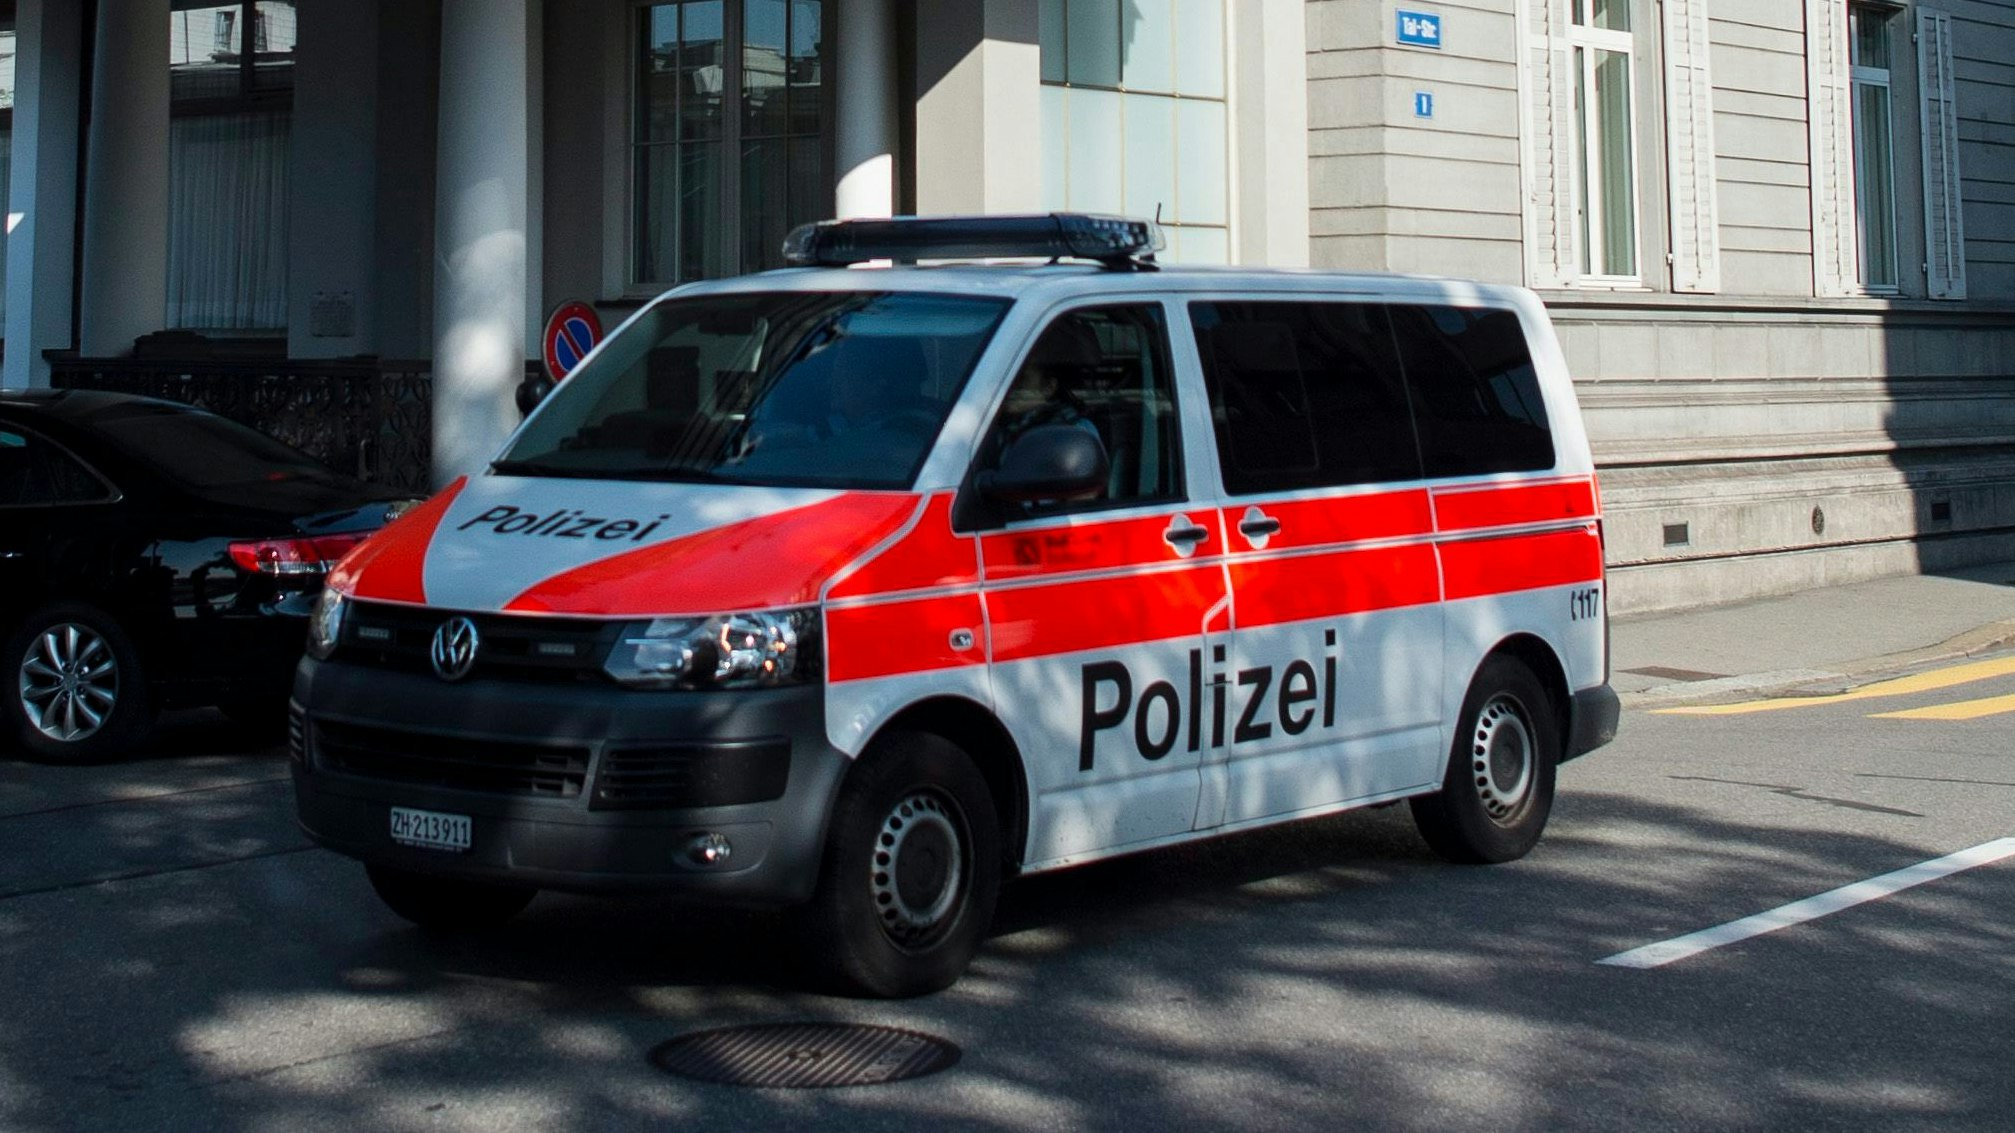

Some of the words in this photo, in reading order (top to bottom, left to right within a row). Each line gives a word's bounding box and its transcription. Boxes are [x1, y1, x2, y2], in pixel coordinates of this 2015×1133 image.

[1421, 95, 1427, 114] 1
[457, 505, 672, 541] Polizei
[1577, 588, 1599, 619] 117
[431, 616, 478, 680] VW
[1079, 628, 1336, 772] Polizei
